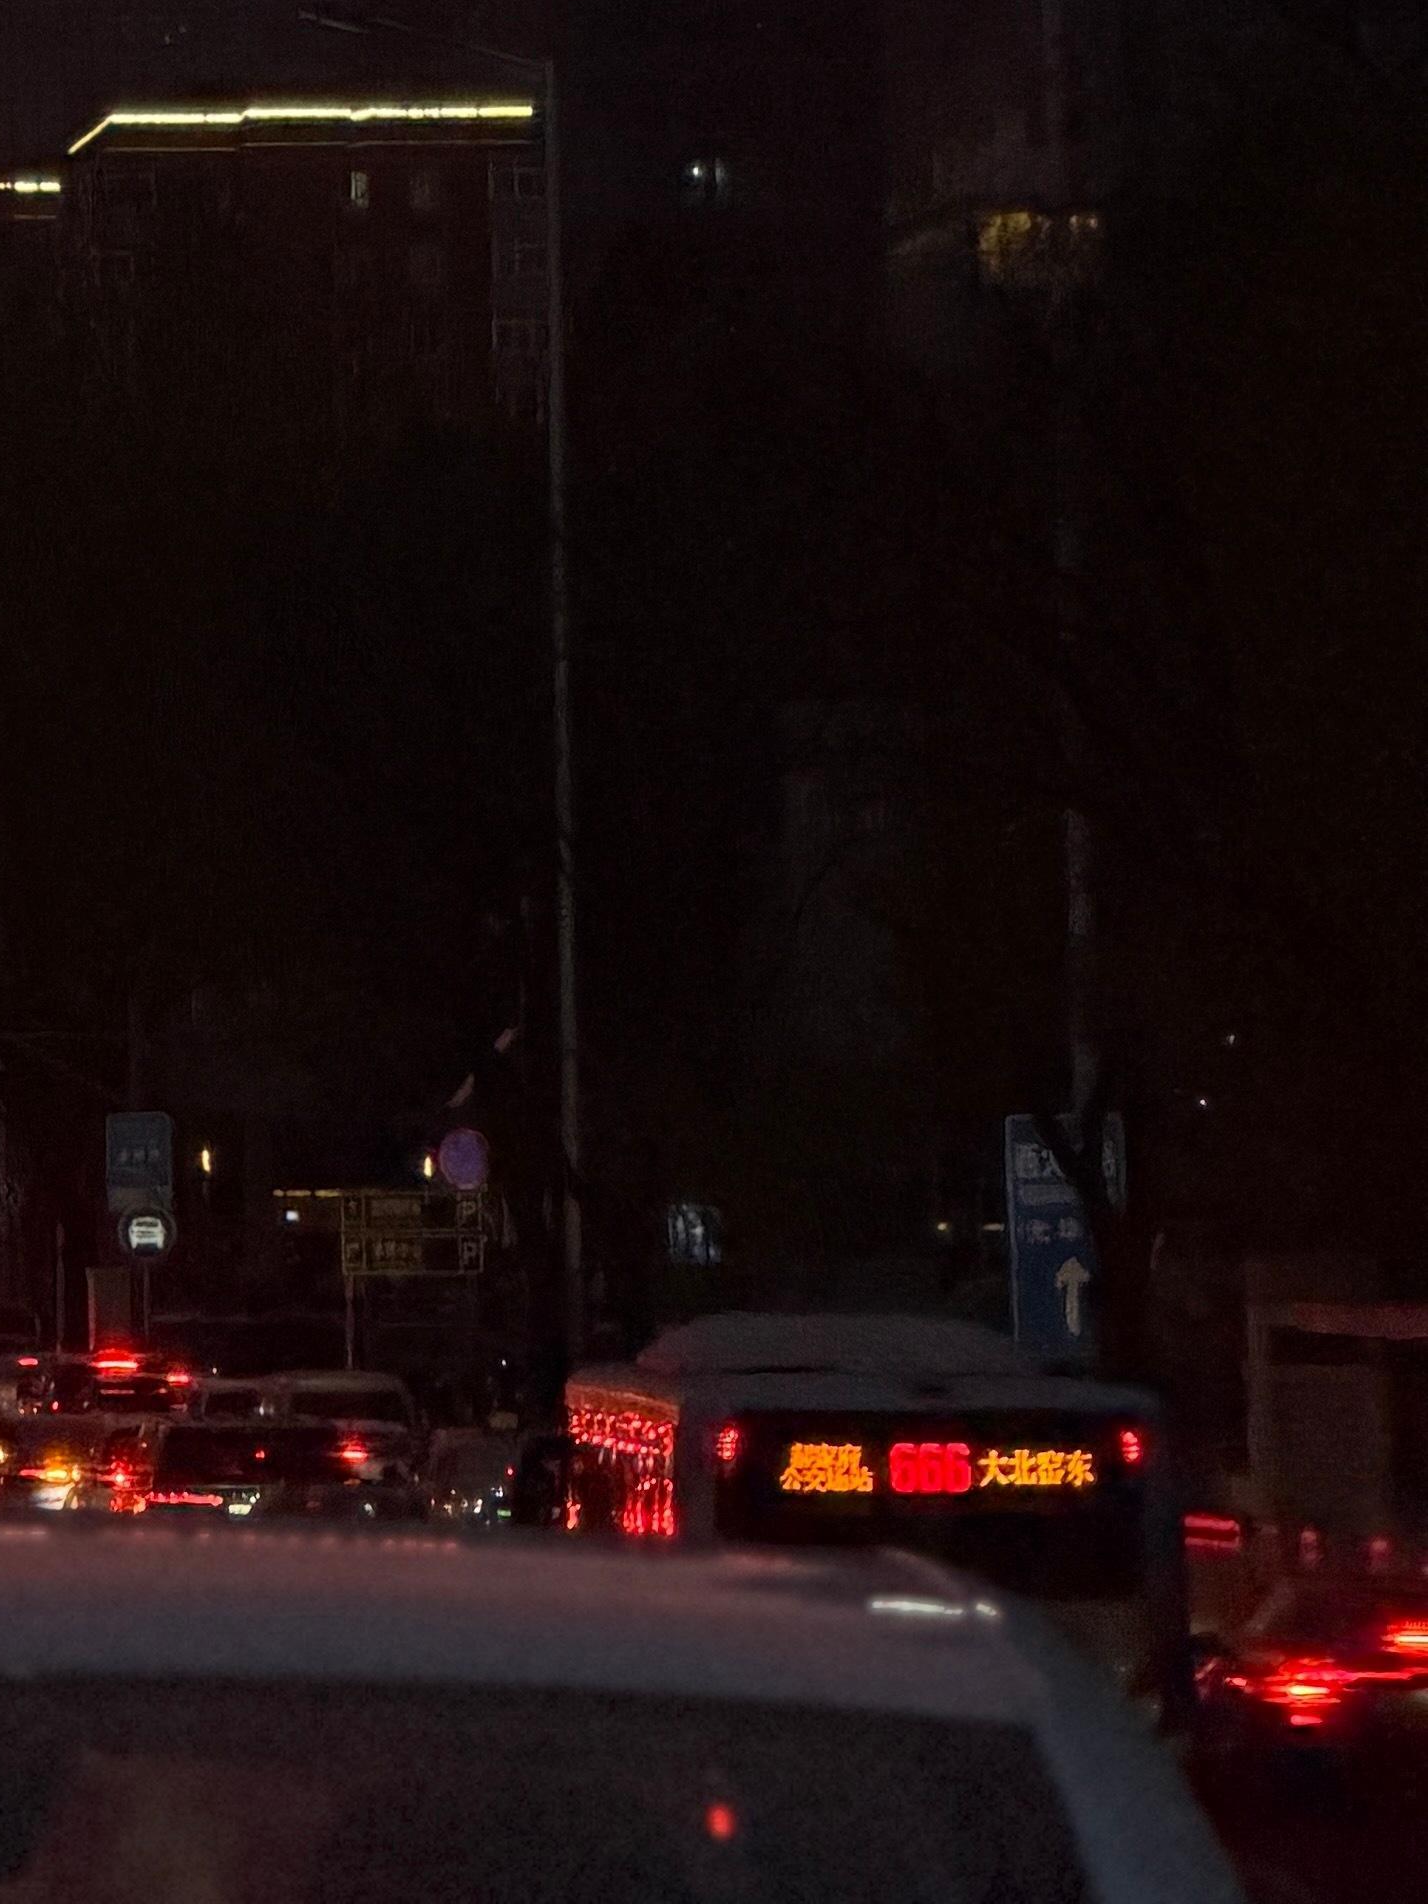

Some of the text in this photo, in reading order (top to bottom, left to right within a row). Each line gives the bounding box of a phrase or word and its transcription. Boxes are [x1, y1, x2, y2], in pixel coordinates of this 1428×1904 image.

[890, 1443, 971, 1493] 666
[978, 1449, 1094, 1487] 大北窑东
